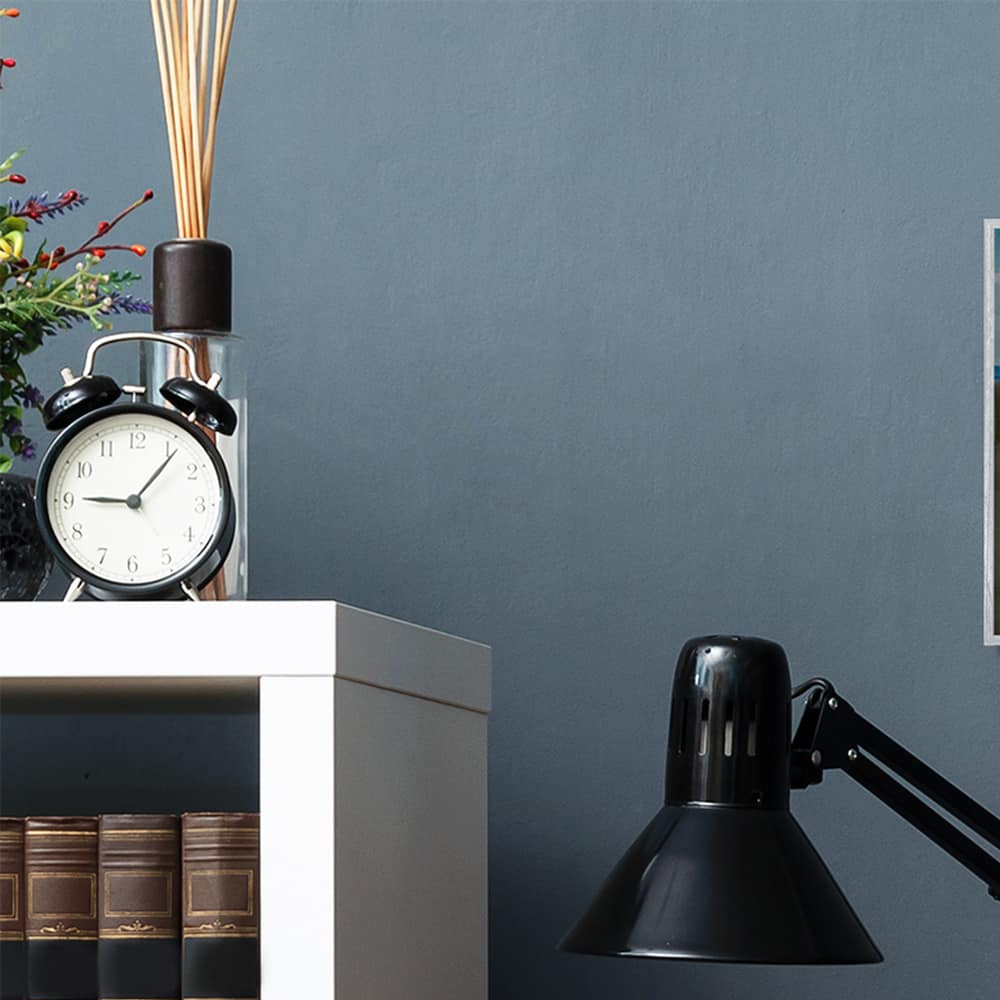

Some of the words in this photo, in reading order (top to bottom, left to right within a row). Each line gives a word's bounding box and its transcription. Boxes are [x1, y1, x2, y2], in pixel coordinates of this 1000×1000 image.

[100, 440, 113, 457] 11
[129, 432, 146, 449] 12
[165, 441, 171, 457] 1
[77, 461, 92, 478] 10
[187, 463, 198, 480] 2
[63, 492, 74, 510] 9
[194, 497, 206, 513] 3
[72, 523, 83, 540] 8
[183, 526, 195, 542] 4
[97, 547, 108, 565] 7
[127, 555, 138, 573] 6
[161, 548, 172, 565] 5
